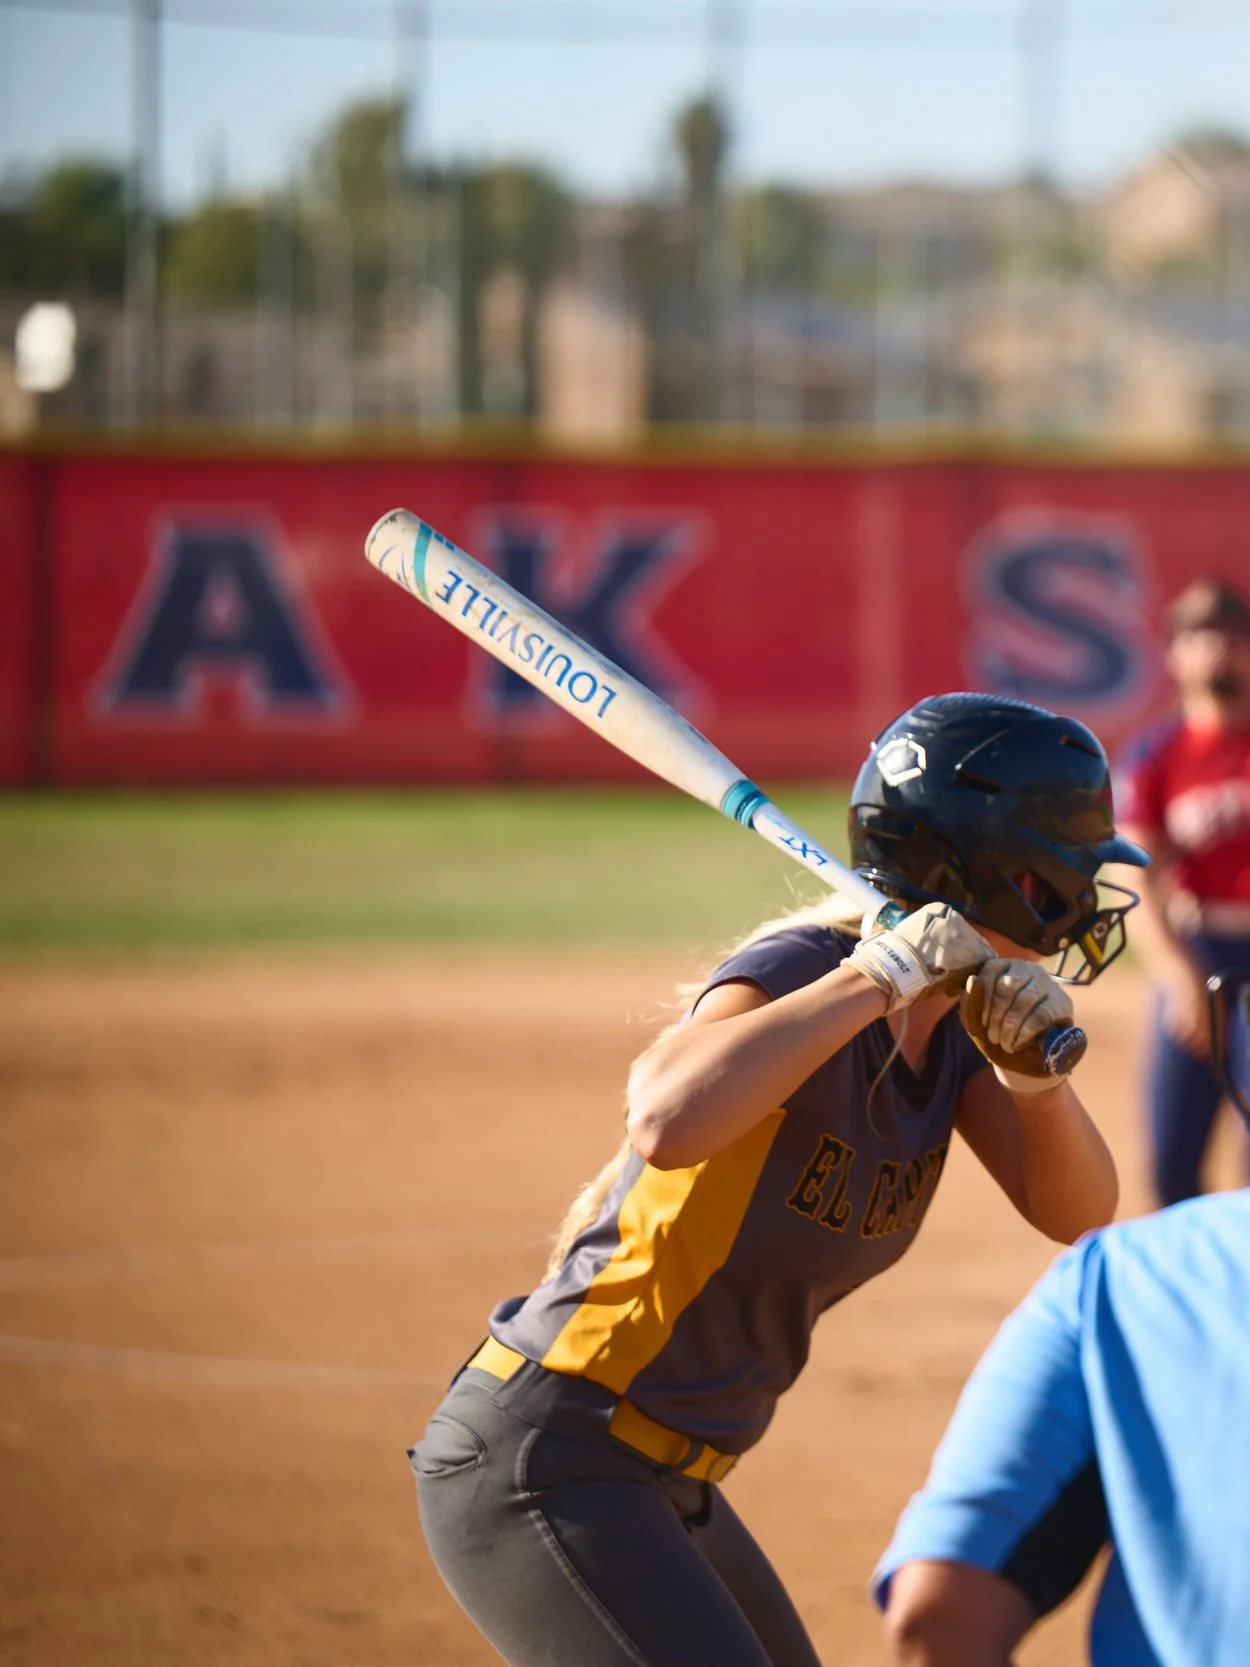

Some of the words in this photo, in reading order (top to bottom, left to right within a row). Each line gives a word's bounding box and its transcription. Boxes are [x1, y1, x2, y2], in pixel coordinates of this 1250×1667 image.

[434, 569, 618, 719] LOUISVILLE
[778, 836, 829, 866] LXT
[785, 1133, 855, 1233] EL
